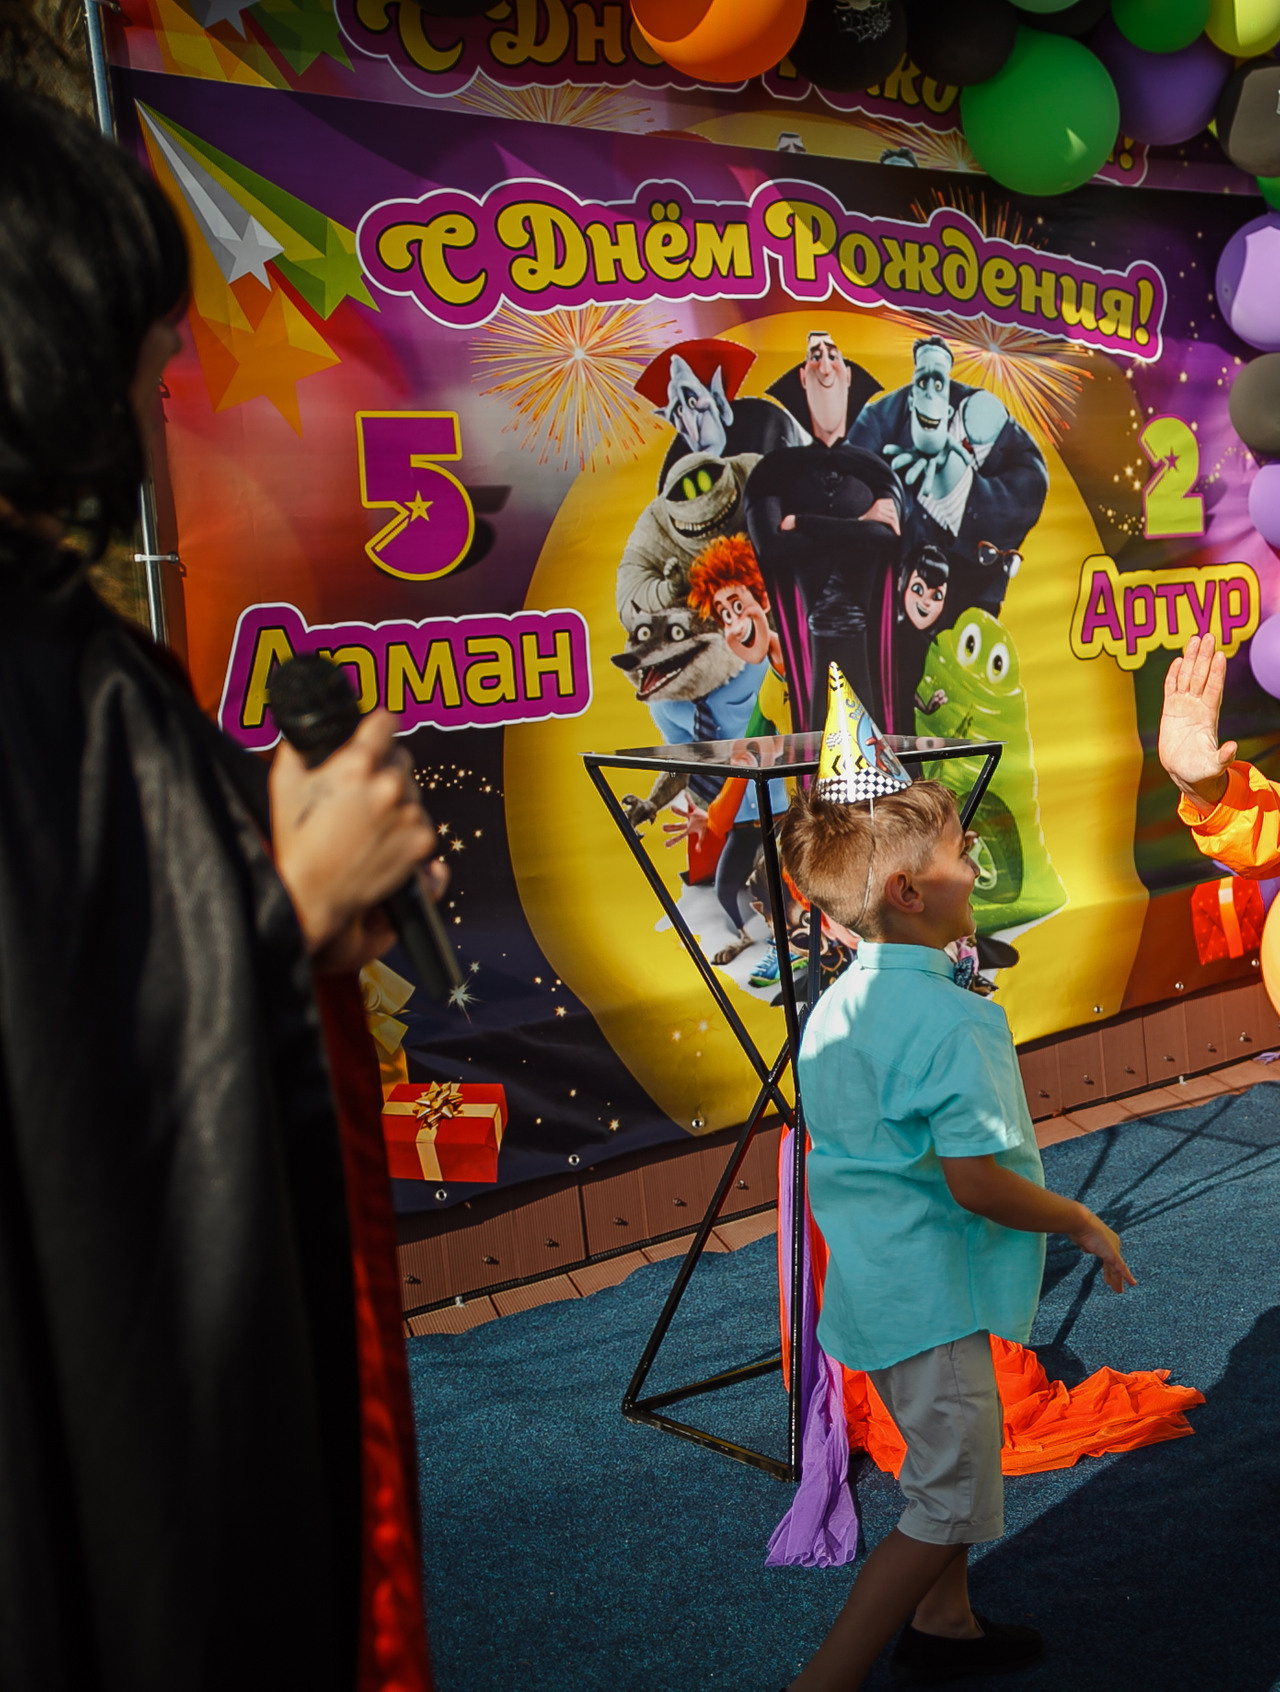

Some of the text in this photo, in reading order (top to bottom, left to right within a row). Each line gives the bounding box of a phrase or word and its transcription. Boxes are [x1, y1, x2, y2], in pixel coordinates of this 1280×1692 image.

[375, 199, 1155, 348] С Днём Рождения!
[355, 410, 475, 581] 5
[1138, 413, 1206, 539] 2
[1080, 569, 1251, 655] Артур
